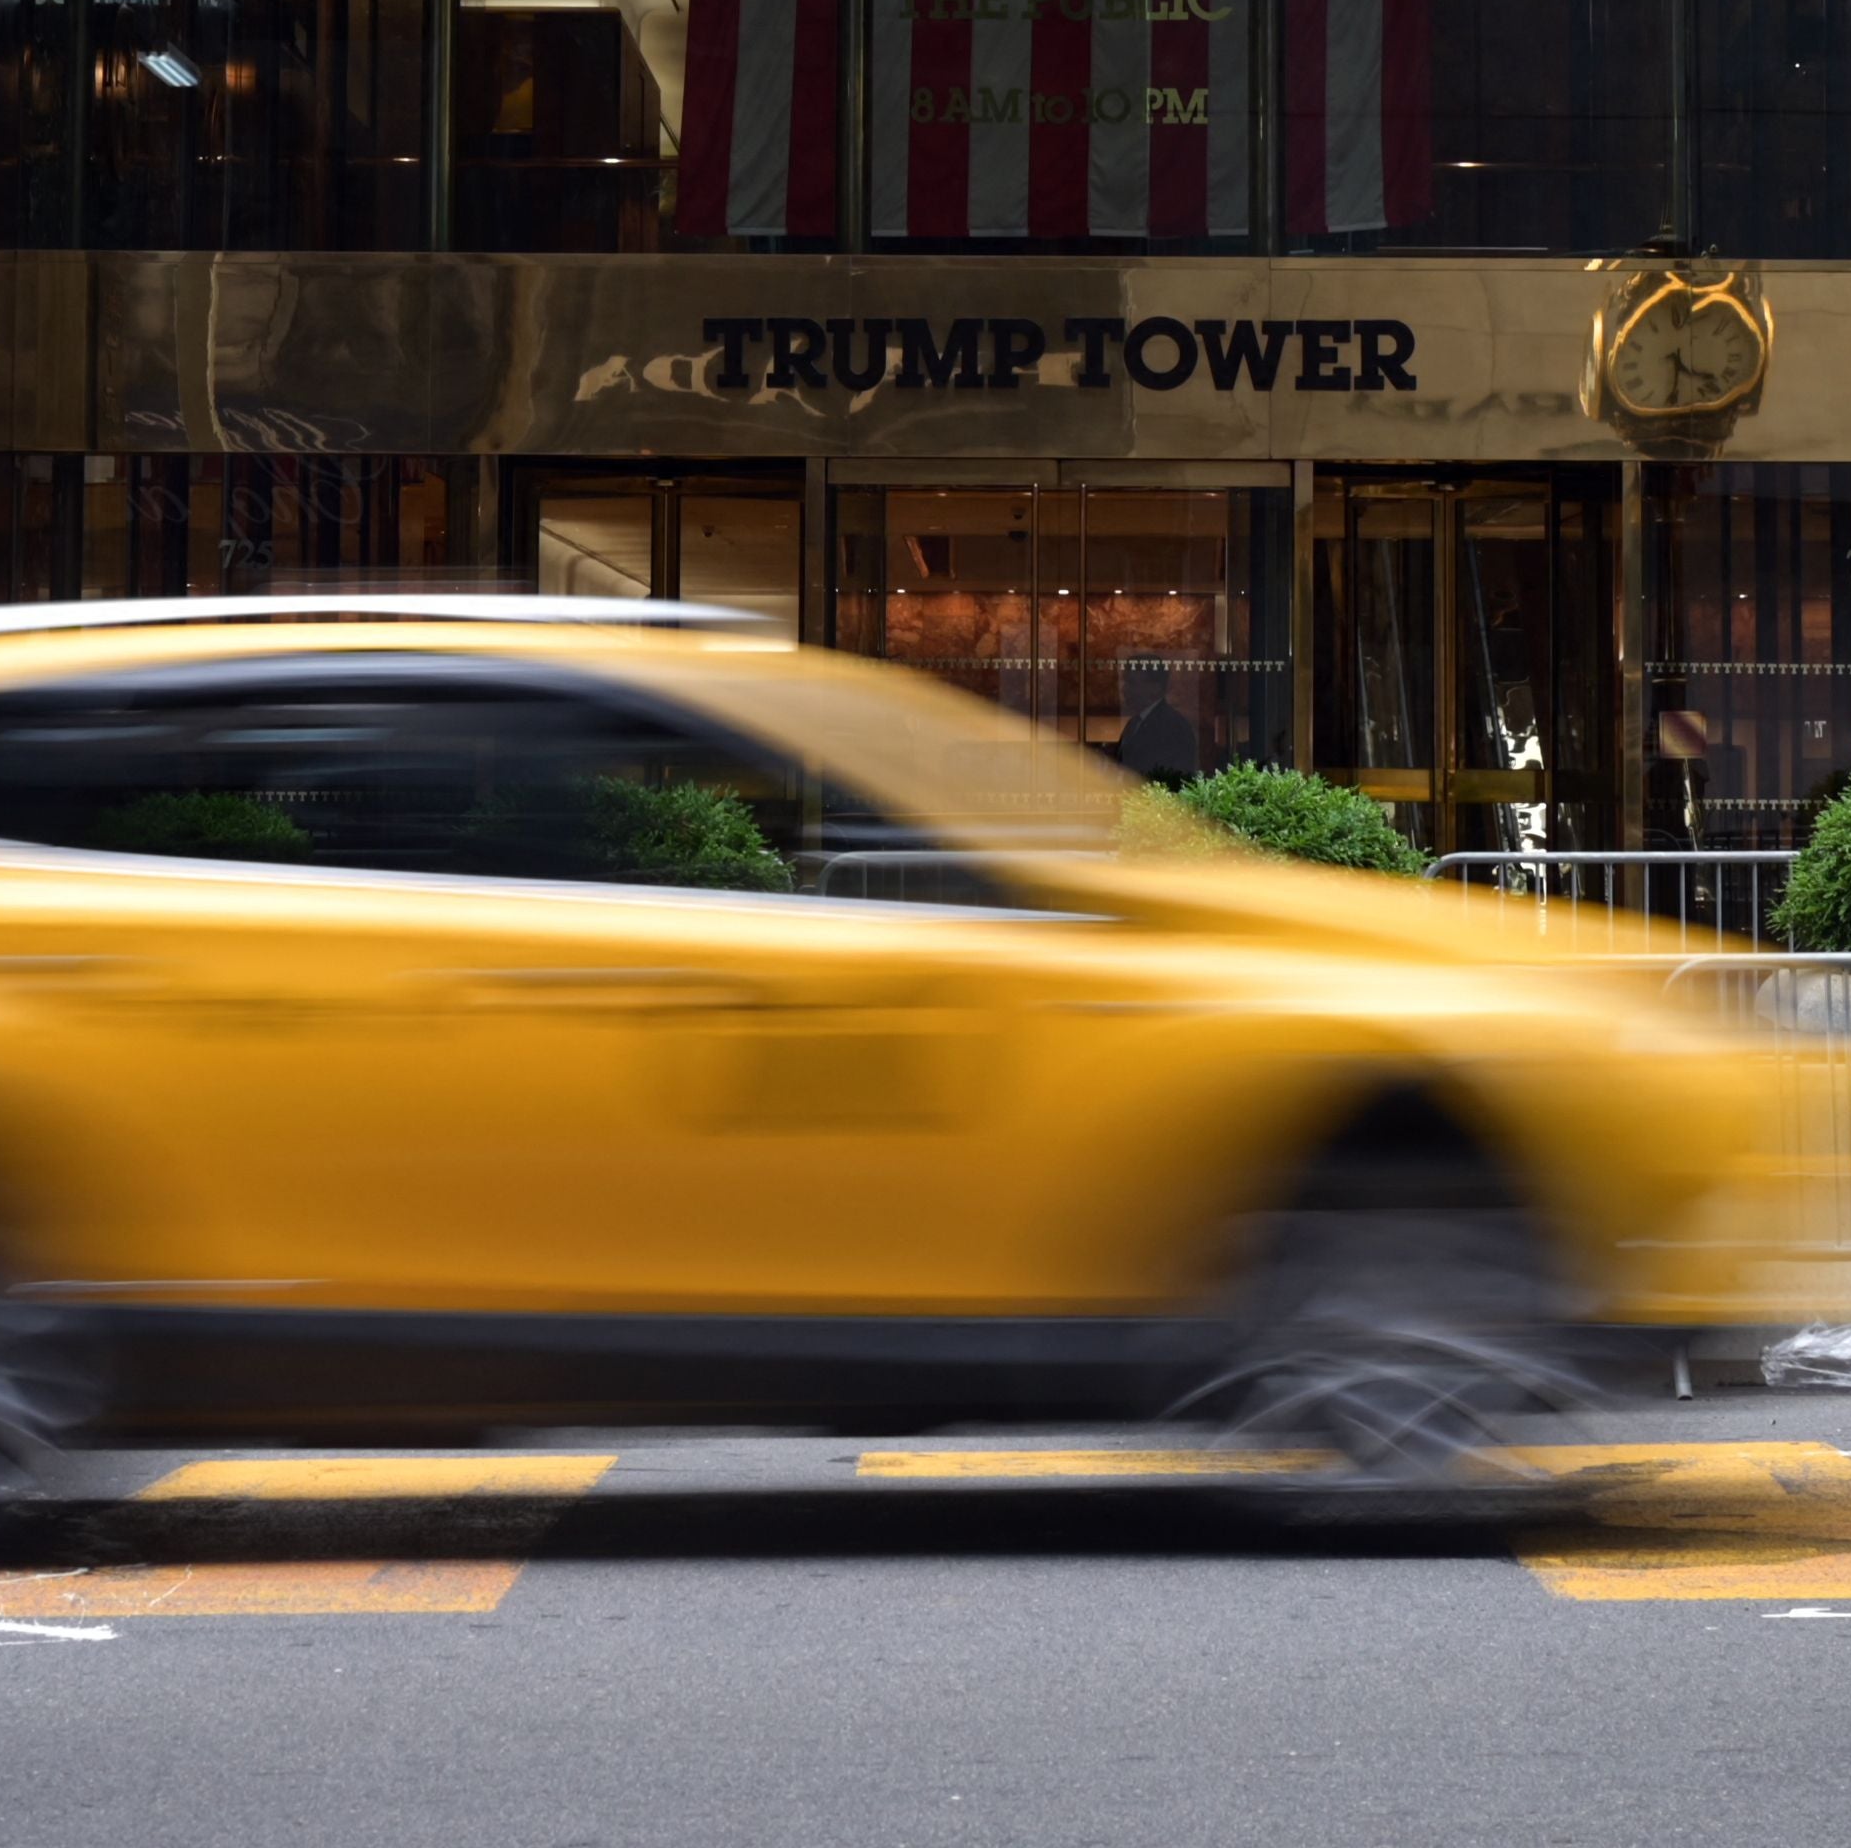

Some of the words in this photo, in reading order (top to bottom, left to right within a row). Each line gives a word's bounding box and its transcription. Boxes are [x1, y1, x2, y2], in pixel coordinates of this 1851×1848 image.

[911, 87, 934, 124] 8
[939, 87, 1024, 124] AM
[1031, 89, 1074, 124] to
[1081, 87, 1132, 124] 10
[1144, 87, 1210, 125] PM
[702, 316, 1046, 391] TRUMP
[1063, 315, 1418, 391] TOWER
[218, 539, 274, 569] 725
